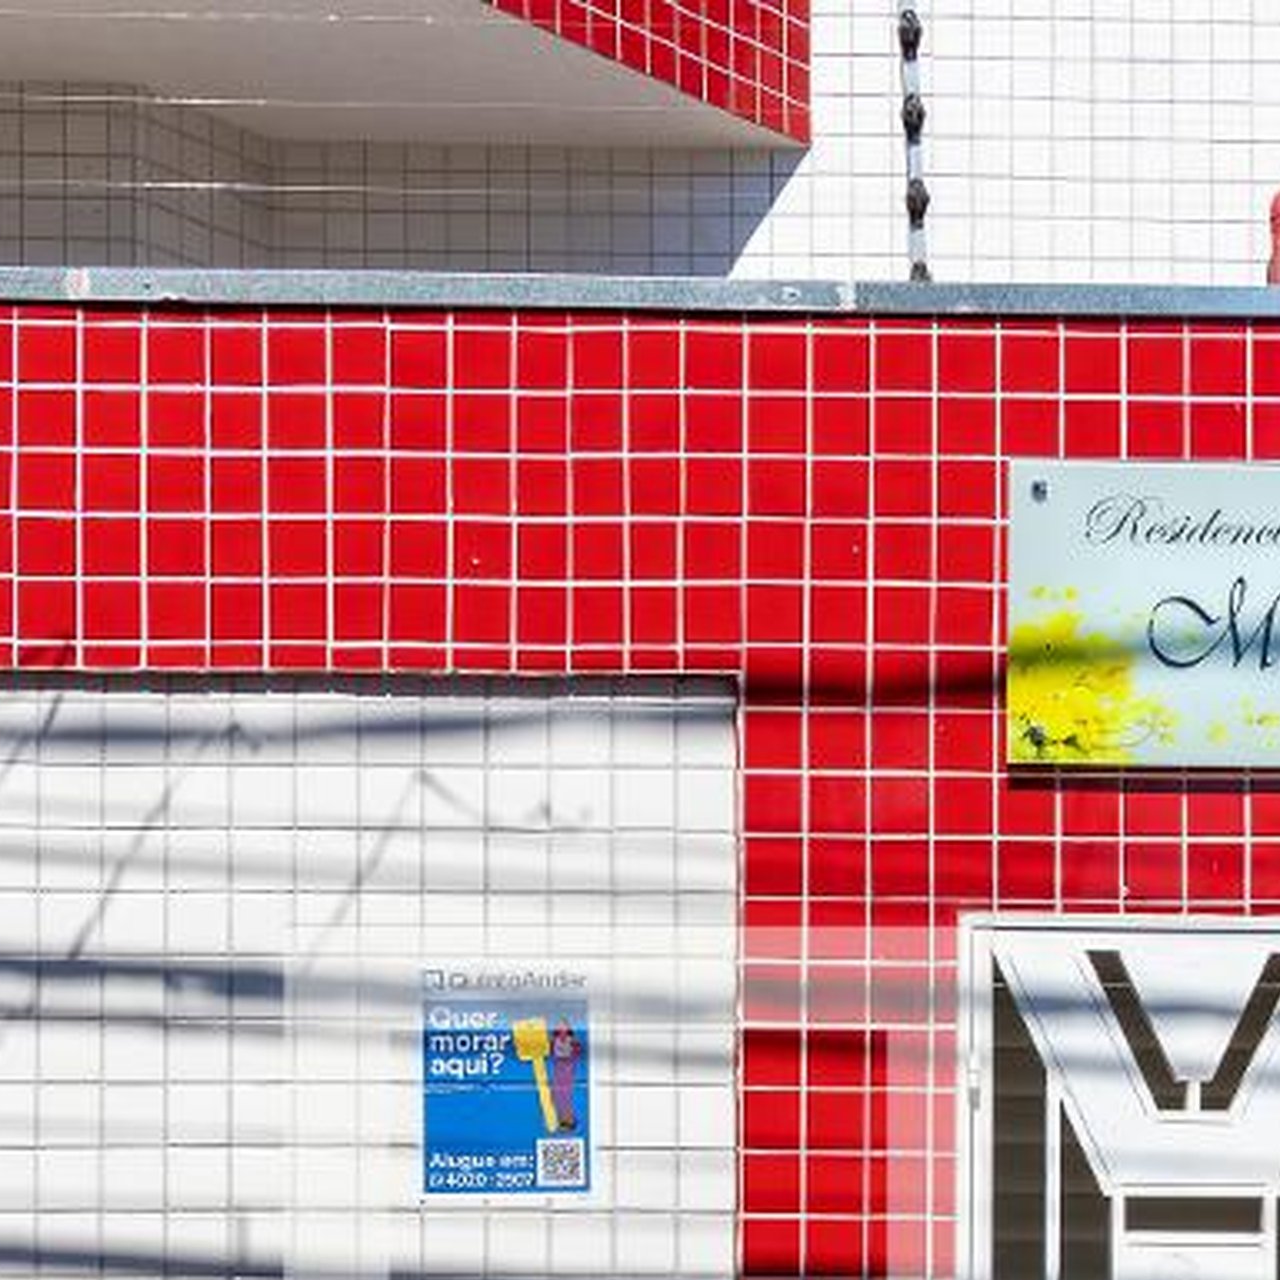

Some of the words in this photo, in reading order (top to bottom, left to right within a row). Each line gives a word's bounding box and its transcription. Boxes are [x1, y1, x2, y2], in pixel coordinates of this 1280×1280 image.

[429, 1007, 499, 1029] Quer
[429, 1033, 511, 1051] morar
[429, 1053, 505, 1079] aqui?
[429, 1152, 496, 1173] Alugue
